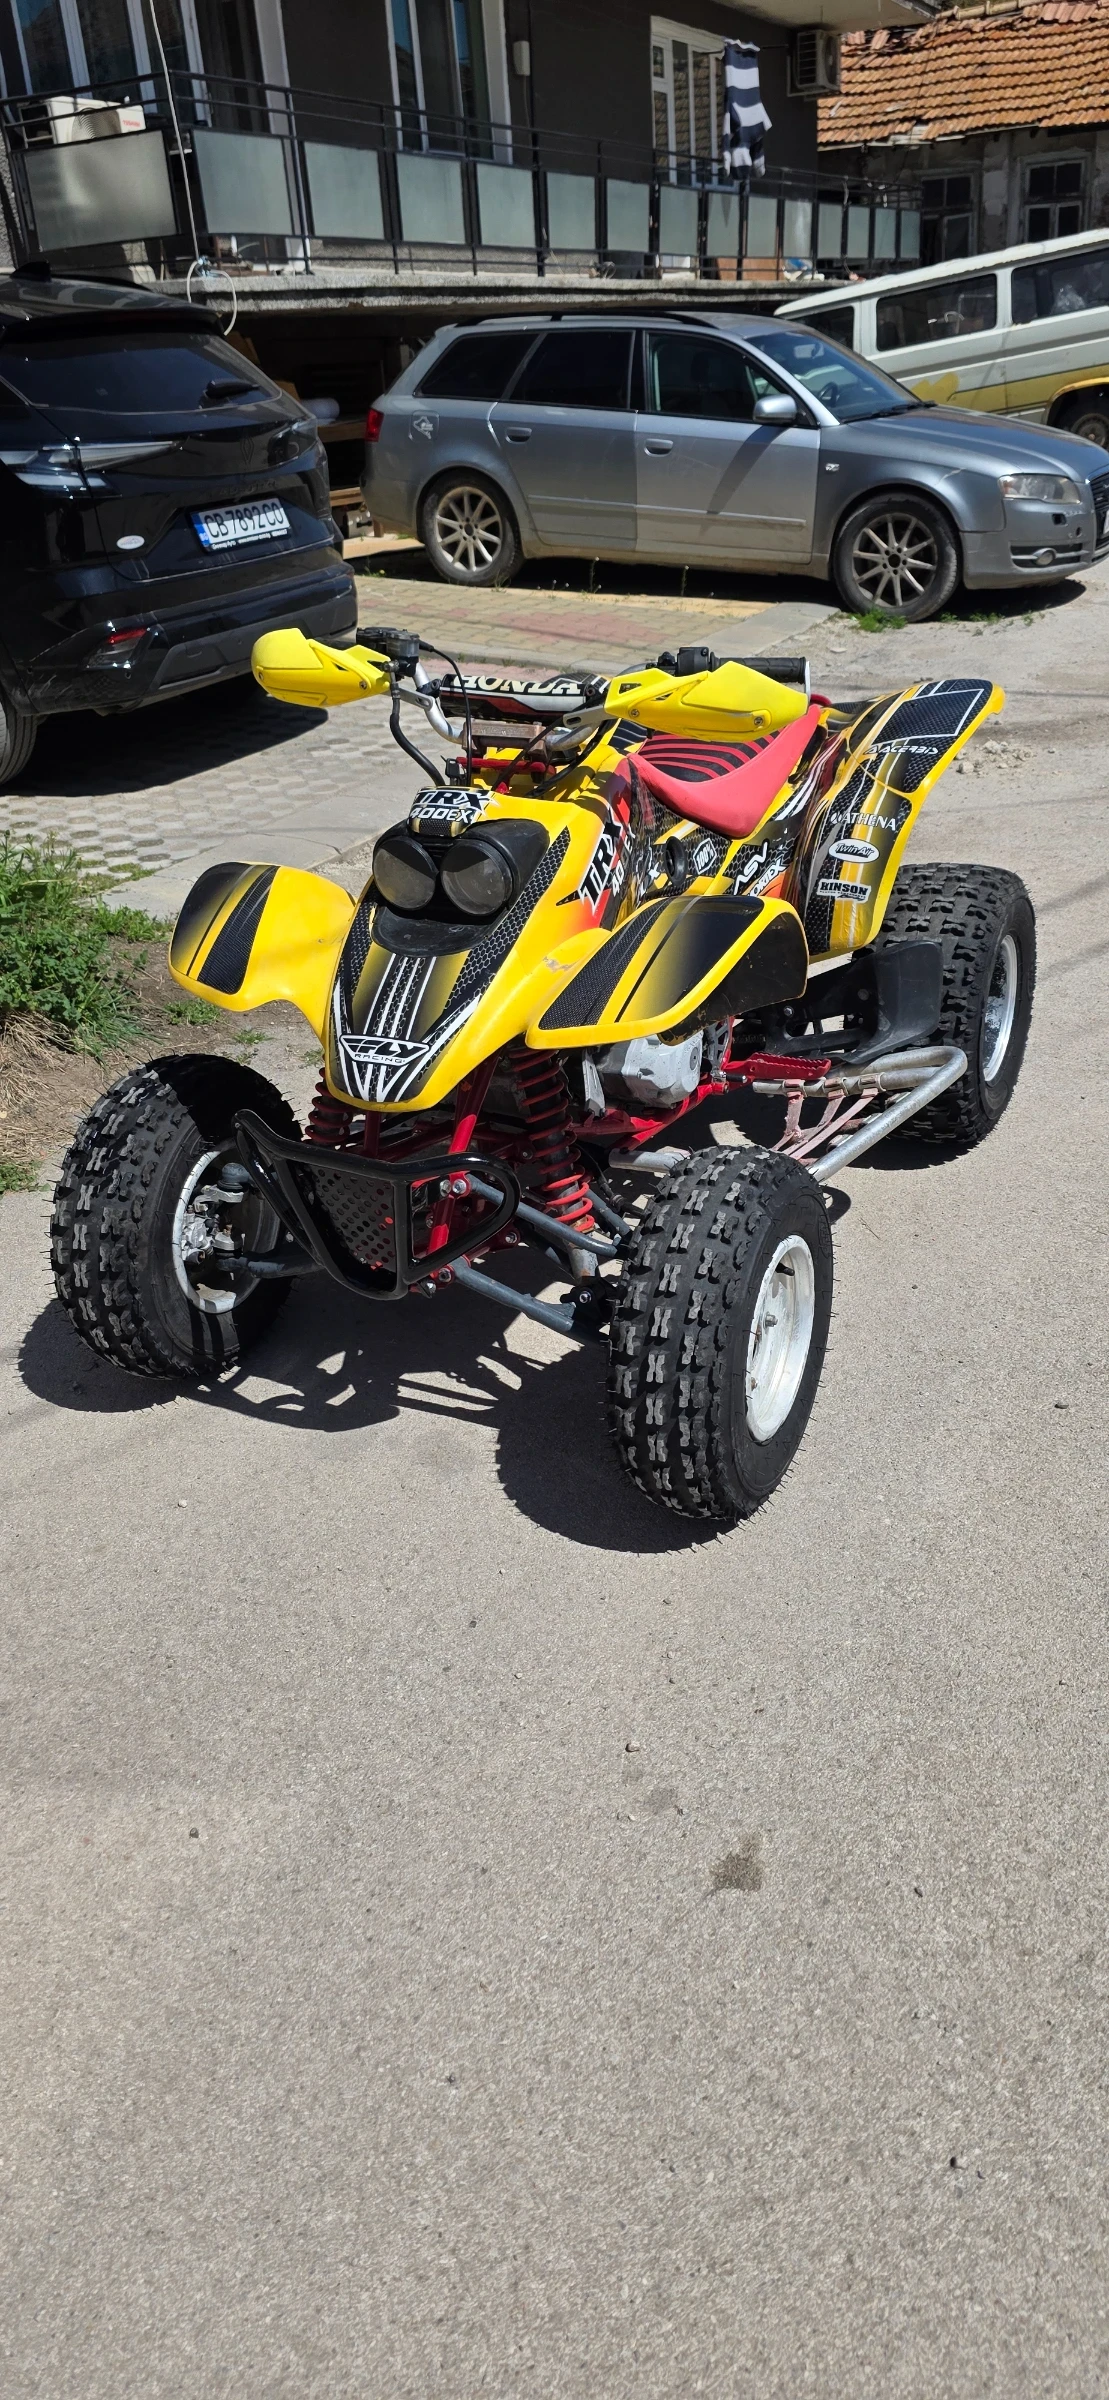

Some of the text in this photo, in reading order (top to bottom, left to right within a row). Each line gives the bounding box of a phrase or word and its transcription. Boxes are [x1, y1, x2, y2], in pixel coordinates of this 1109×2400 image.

[453, 675, 582, 695] HONDA
[413, 788, 493, 813] TRX
[409, 807, 472, 824] 400EX
[840, 812, 897, 831] ATHENA
[696, 843, 714, 870] 100%
[820, 881, 869, 896] HINSON
[343, 1037, 427, 1059] FLY
[354, 1053, 403, 1064] RACING
